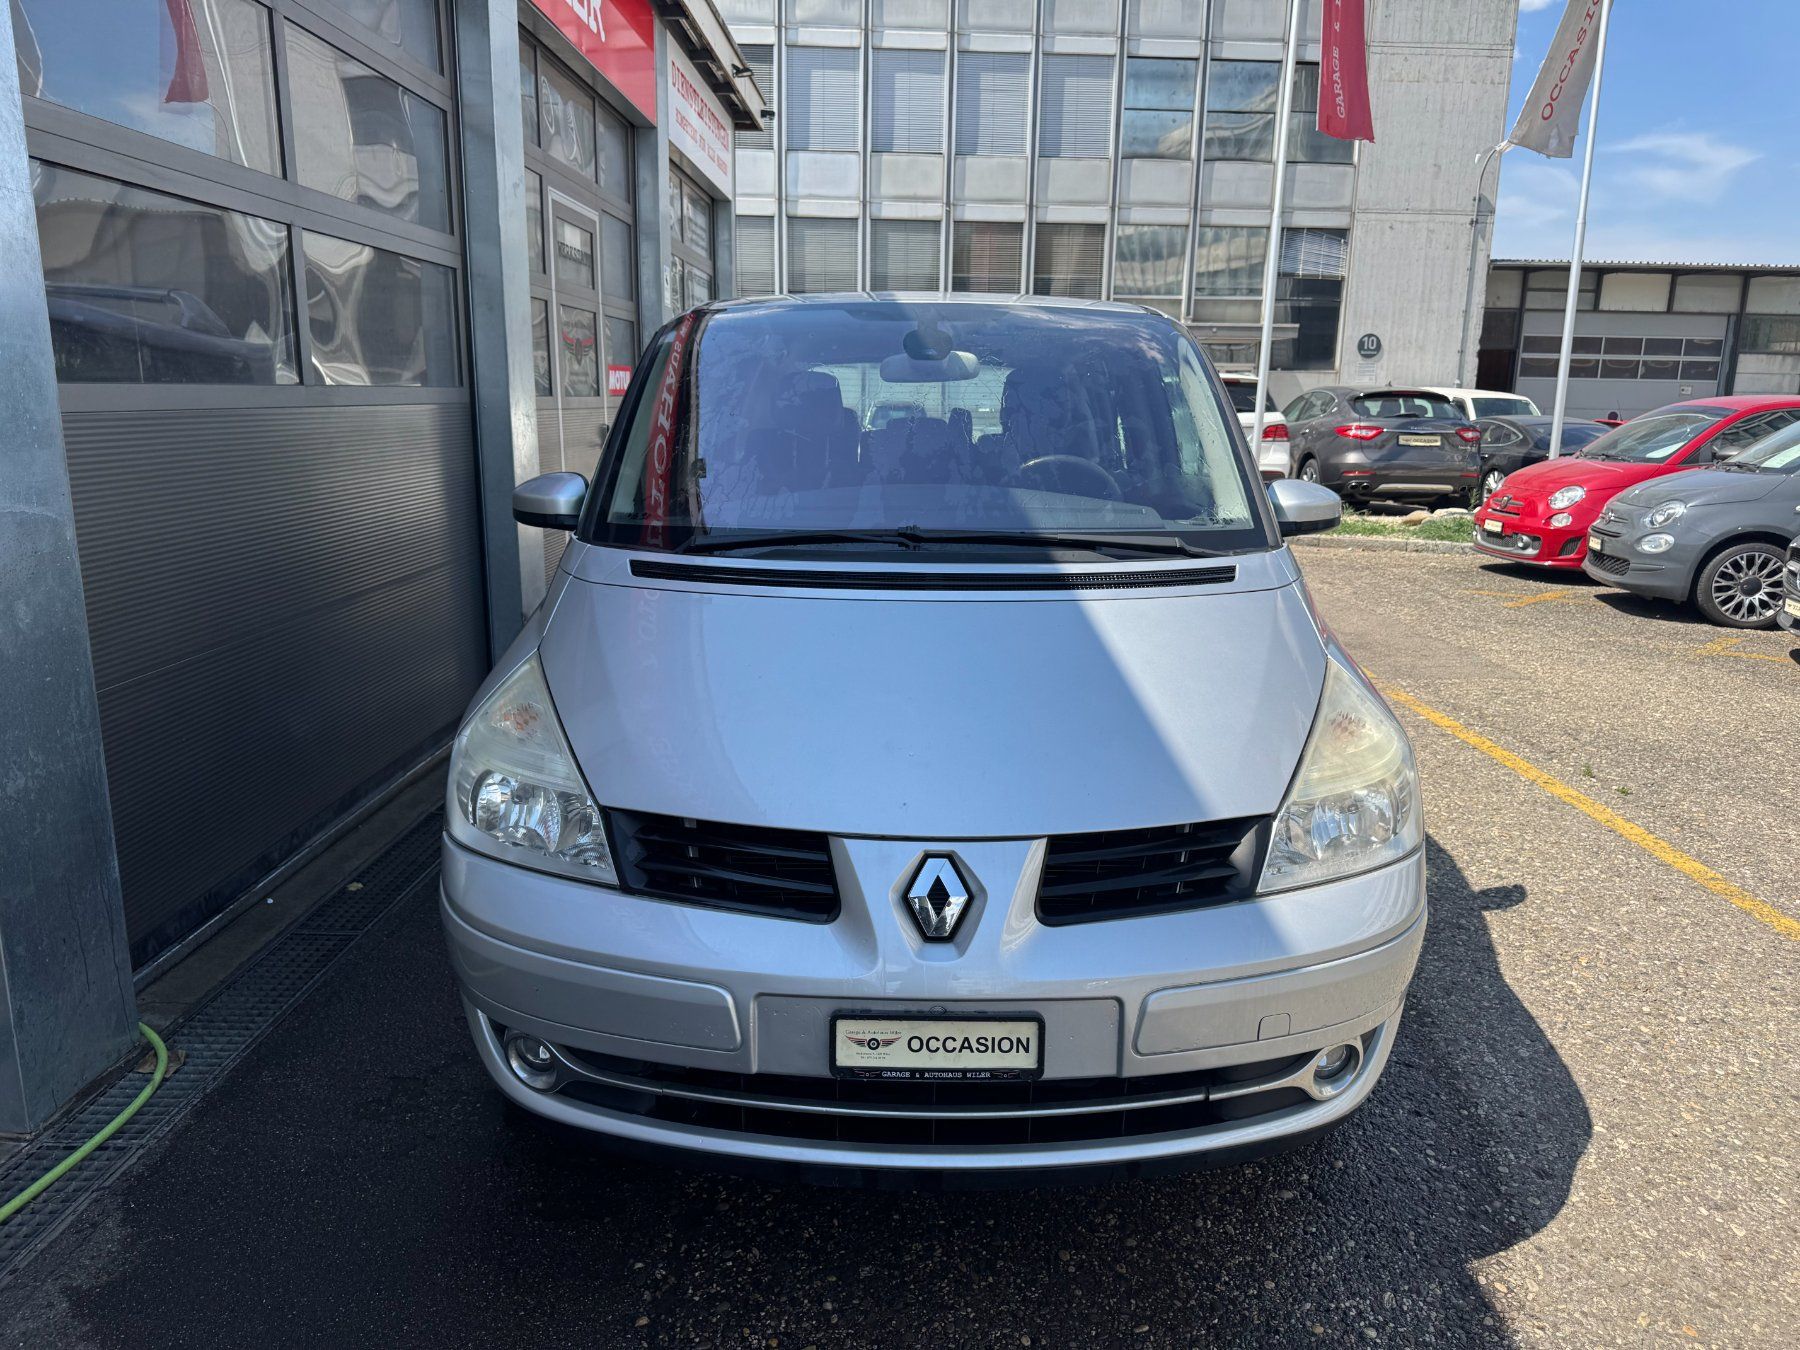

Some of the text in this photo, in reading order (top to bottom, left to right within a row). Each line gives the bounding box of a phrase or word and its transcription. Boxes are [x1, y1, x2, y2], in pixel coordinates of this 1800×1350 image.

[1333, 46, 1345, 118] GARAGE
[1362, 336, 1377, 350] 10
[907, 1036, 1030, 1053] OCCASION
